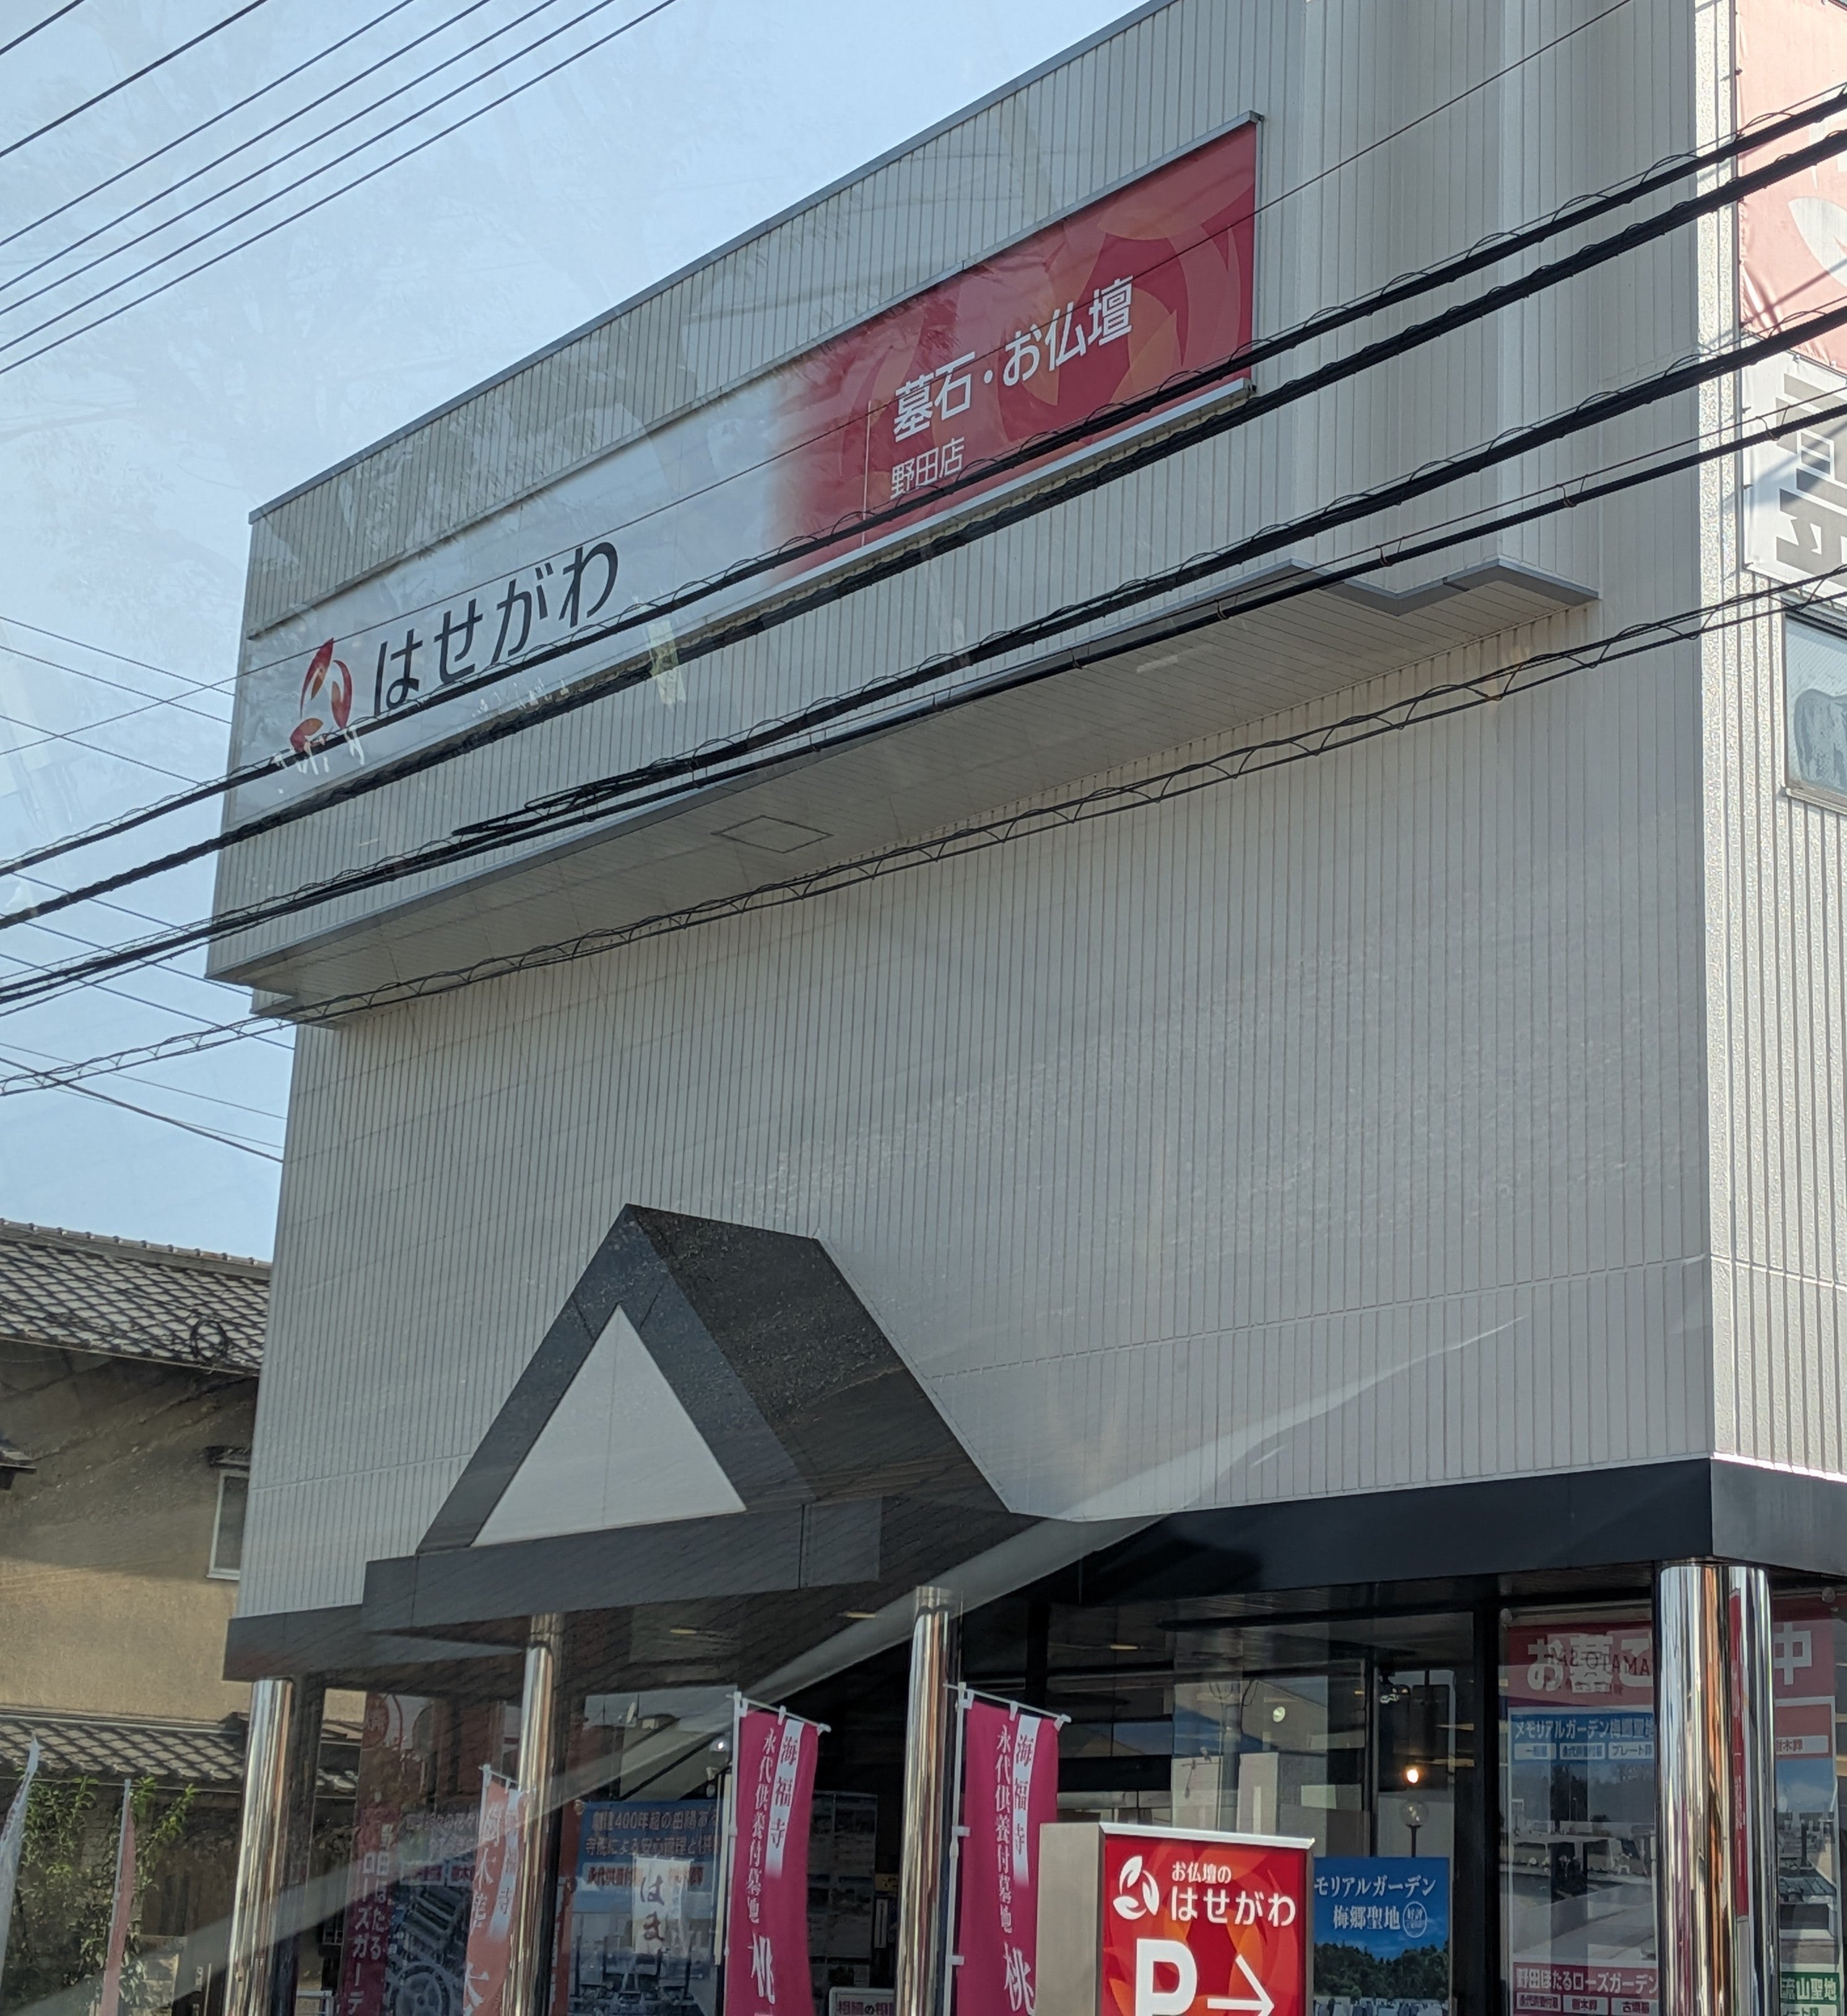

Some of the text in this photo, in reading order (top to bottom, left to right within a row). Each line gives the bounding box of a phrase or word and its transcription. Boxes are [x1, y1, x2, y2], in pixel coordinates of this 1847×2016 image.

[890, 437, 965, 500] 野田店
[374, 541, 619, 716] はせがわ
[1171, 1862, 1232, 1884] お仏壇の
[1171, 1886, 1296, 1927] はせがわ
[1136, 1938, 1197, 2016] P
